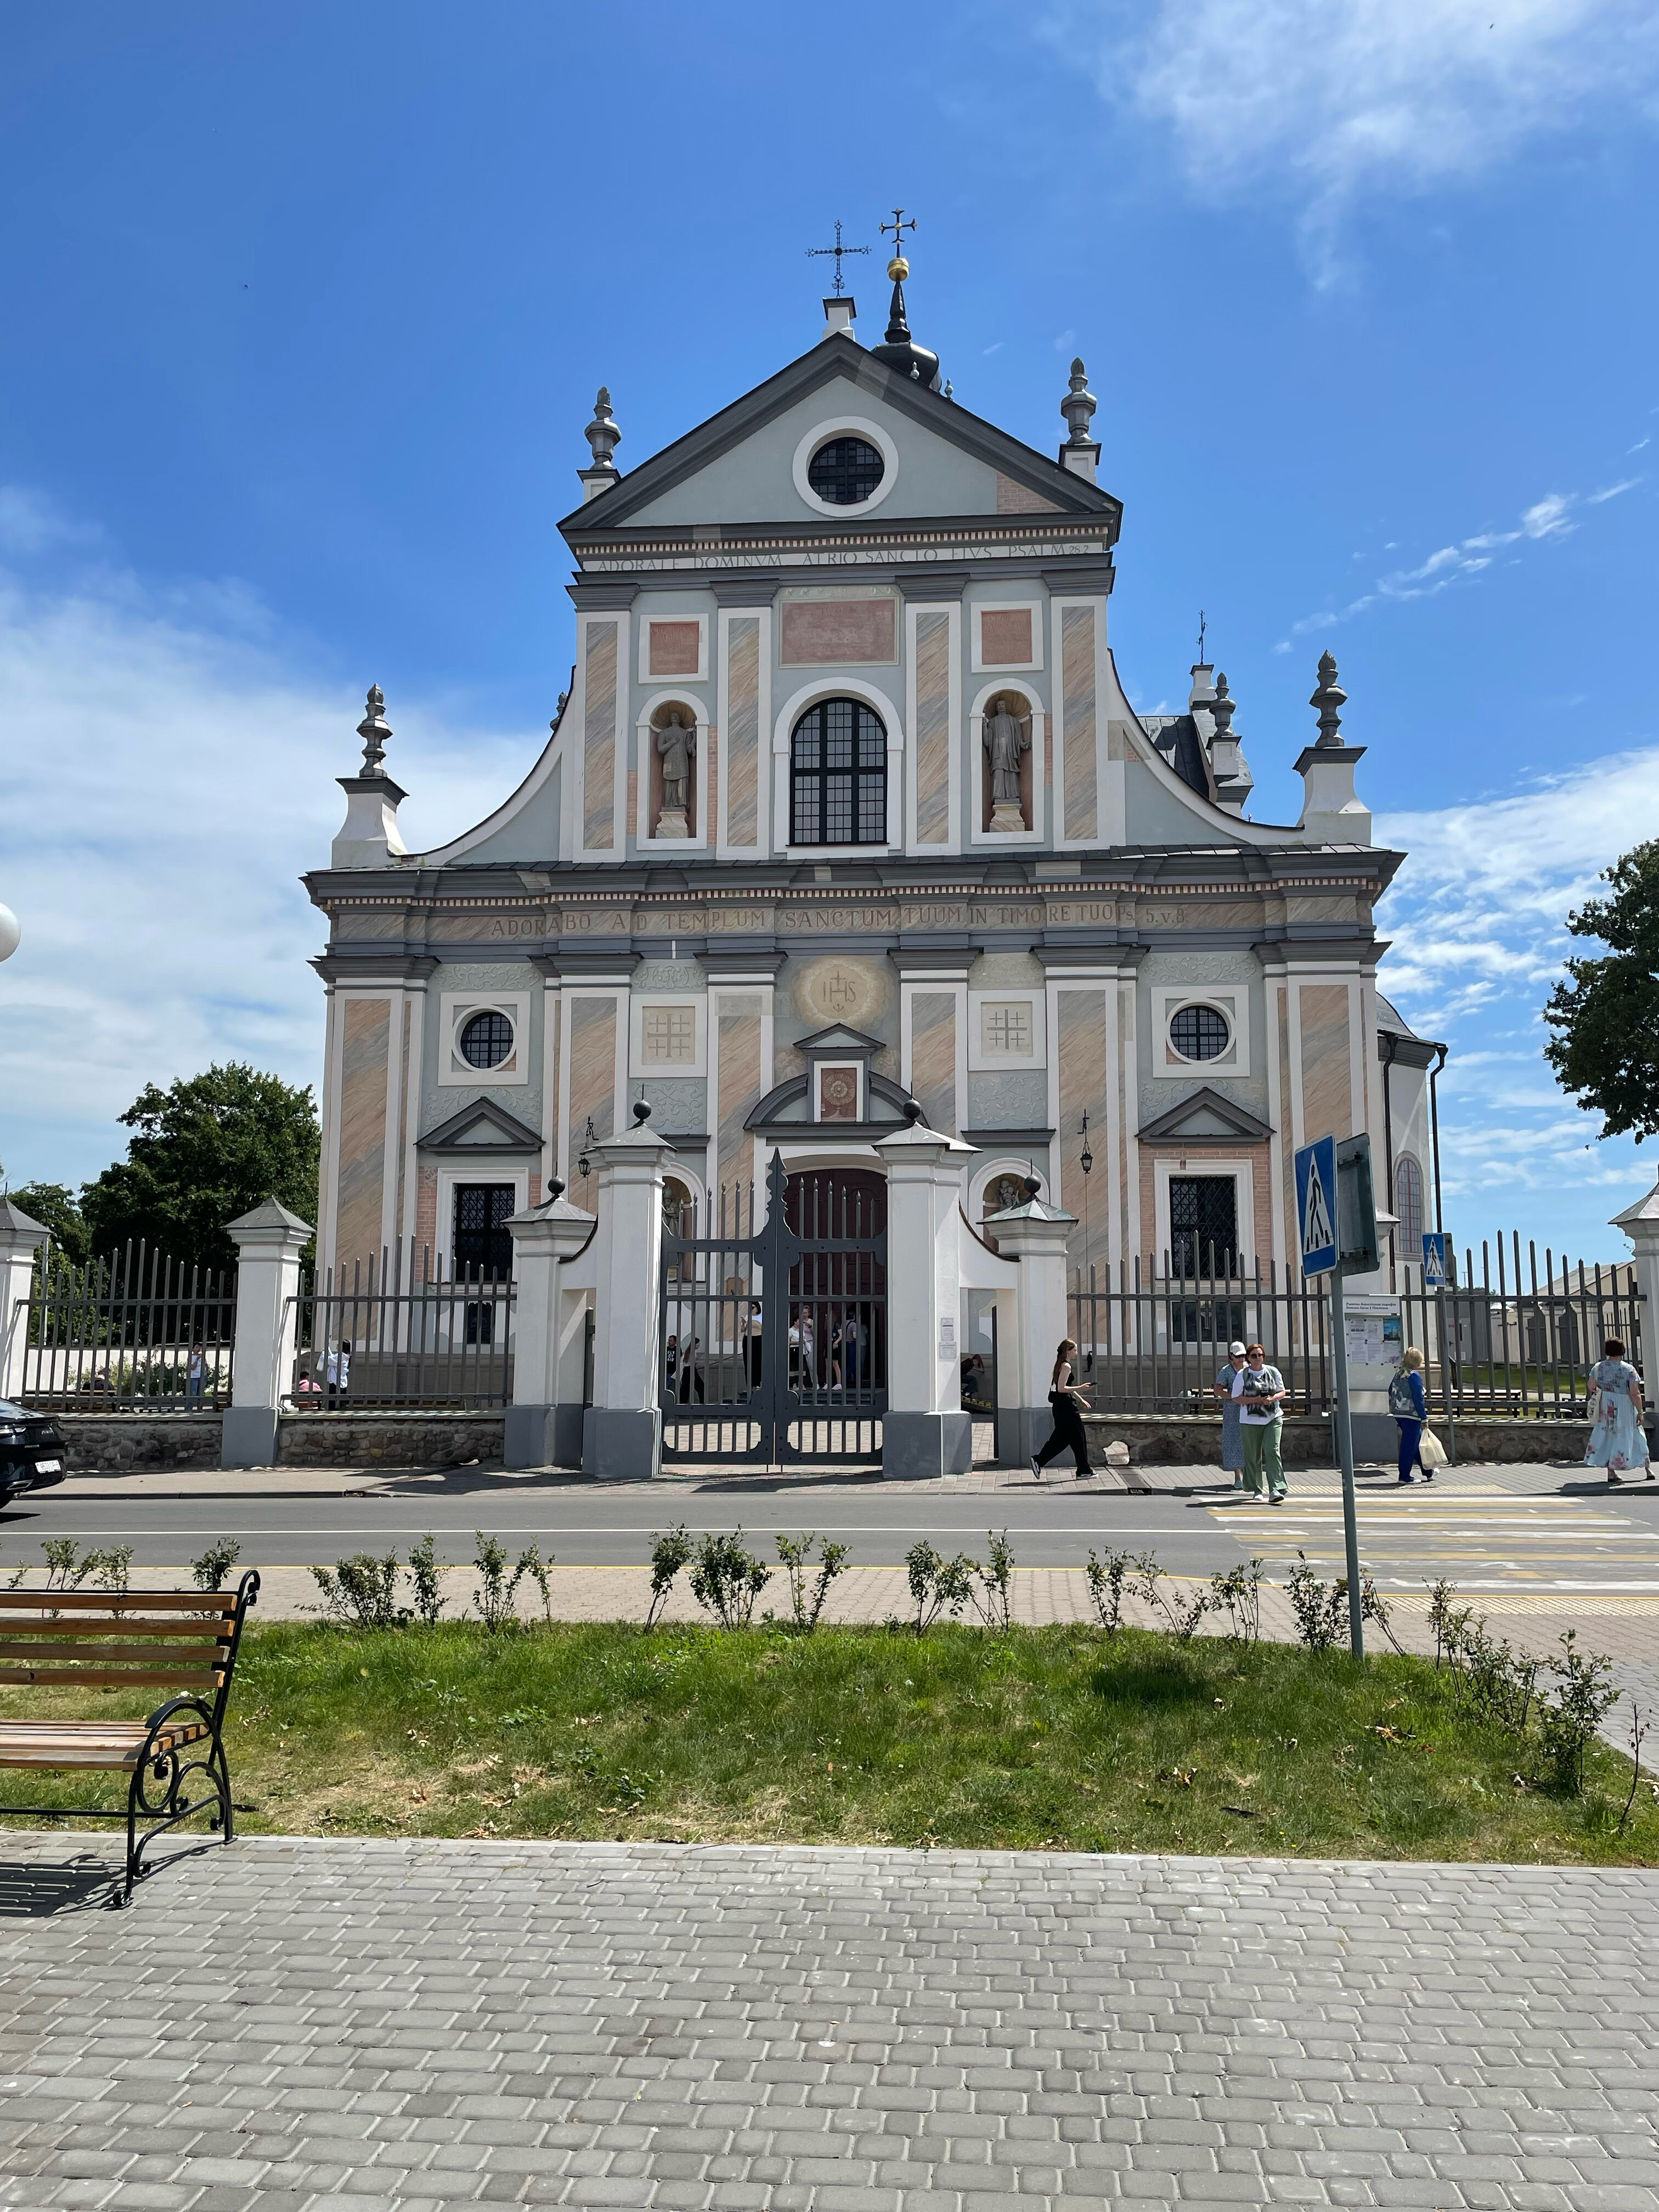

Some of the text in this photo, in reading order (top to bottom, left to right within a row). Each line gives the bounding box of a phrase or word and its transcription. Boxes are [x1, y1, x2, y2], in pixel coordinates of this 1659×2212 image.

[693, 555, 782, 569] DOMINVM
[803, 551, 857, 565] ATRIO
[490, 913, 591, 935] ADORABO
[611, 913, 647, 930] AD
[663, 911, 765, 930] TEMPLUM
[786, 910, 892, 928] SANCTUM
[904, 906, 961, 924] TUUM
[969, 908, 988, 924] IN
[997, 905, 1070, 924] TIMORE
[1076, 904, 1113, 921] TUO
[823, 980, 856, 1003] IHS
